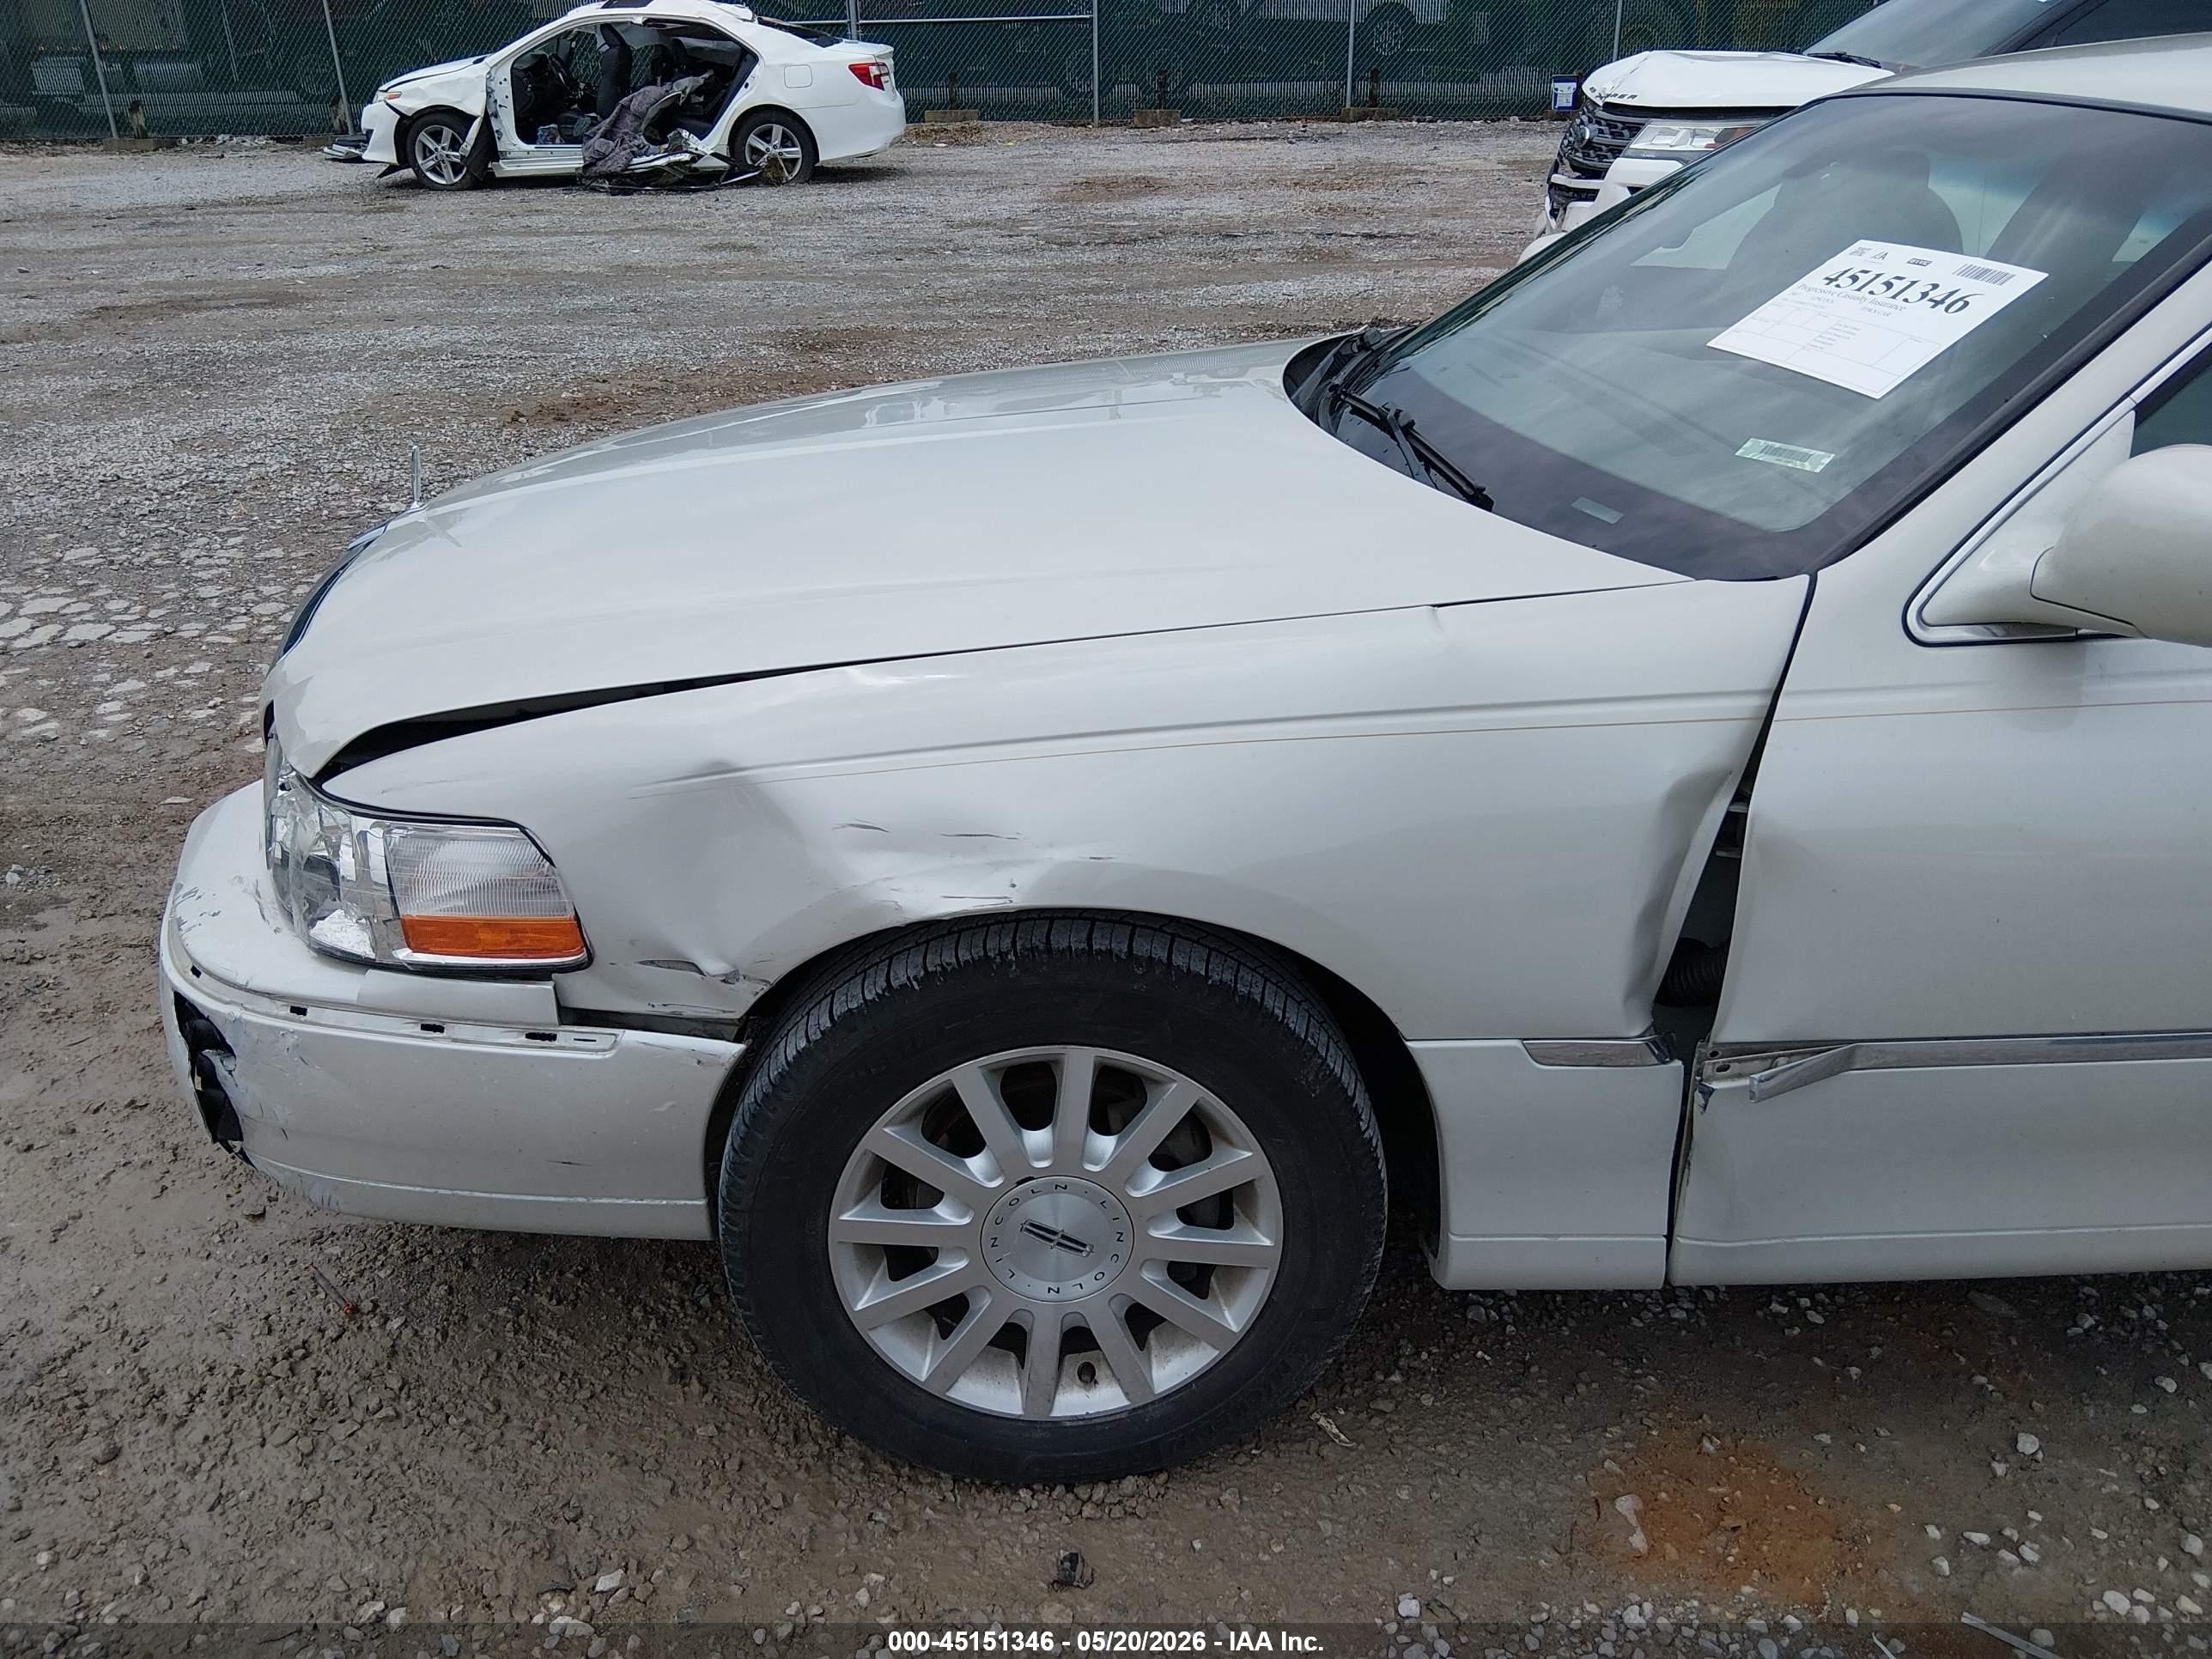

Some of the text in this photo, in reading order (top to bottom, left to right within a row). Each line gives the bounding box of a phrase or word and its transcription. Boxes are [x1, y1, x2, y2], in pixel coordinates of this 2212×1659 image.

[1822, 266, 1985, 314] 45151346
[990, 1183, 1068, 1279] LINCOLN
[1047, 1200, 1124, 1294] LINCOLN
